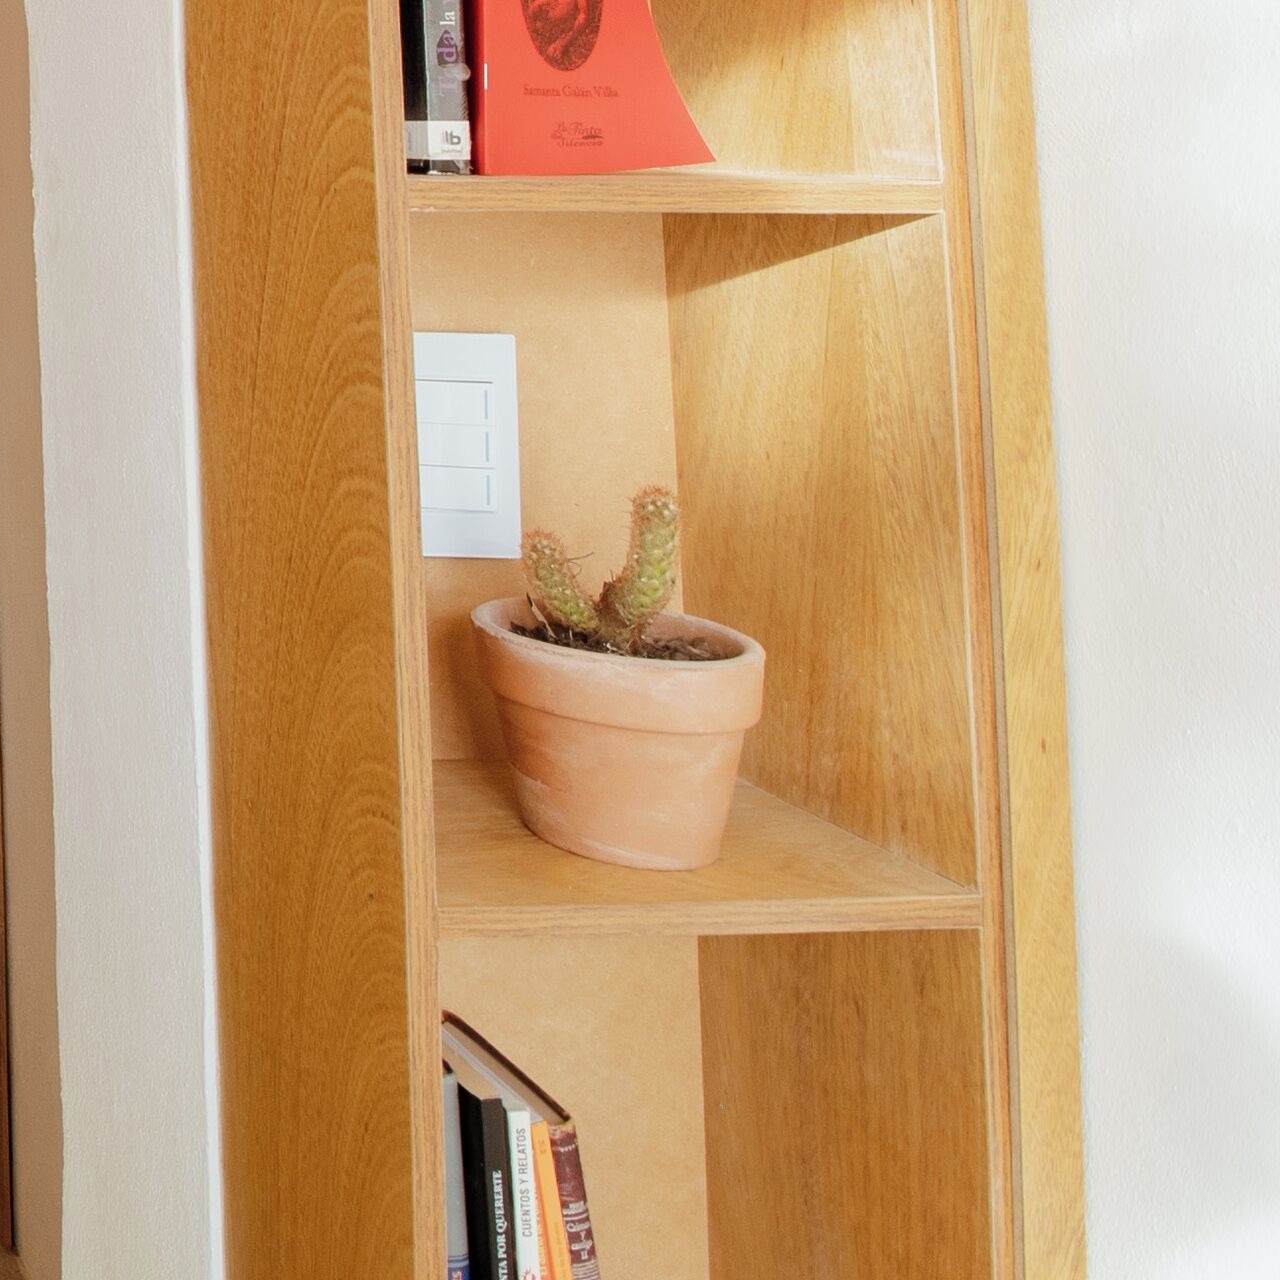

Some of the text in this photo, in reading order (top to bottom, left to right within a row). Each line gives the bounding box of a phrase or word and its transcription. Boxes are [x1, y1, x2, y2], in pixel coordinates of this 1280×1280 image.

[439, 11, 456, 27] la
[516, 1127, 529, 1175] RELATOS
[492, 1170, 508, 1232] QUERERTE
[521, 1189, 533, 1239] CUENTOS
[496, 1233, 507, 1259] POR
